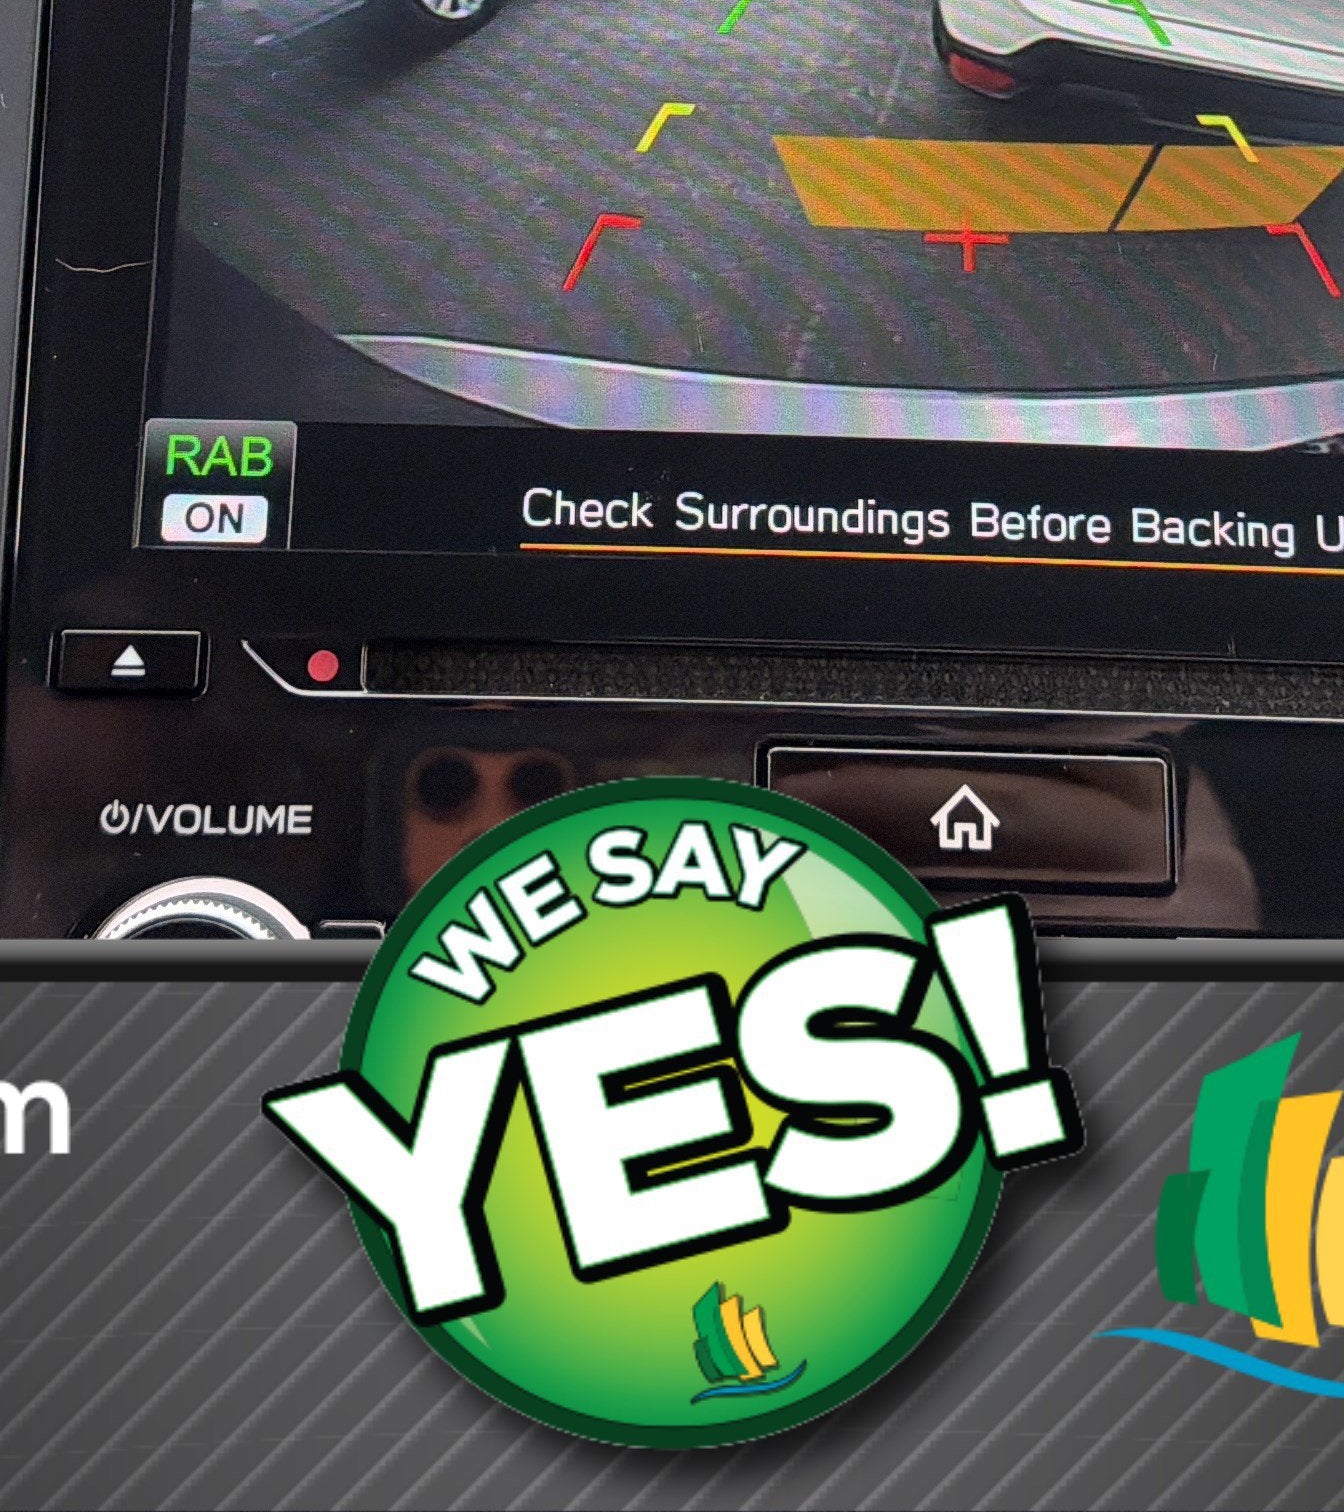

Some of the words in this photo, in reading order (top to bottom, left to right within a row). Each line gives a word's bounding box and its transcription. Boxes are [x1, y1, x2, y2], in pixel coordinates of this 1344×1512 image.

[164, 432, 272, 478] RAB
[182, 502, 245, 534] ON
[521, 488, 653, 533] Check
[674, 491, 952, 550] Surroundings
[970, 502, 1112, 544] Before
[1130, 506, 1296, 558] Backing
